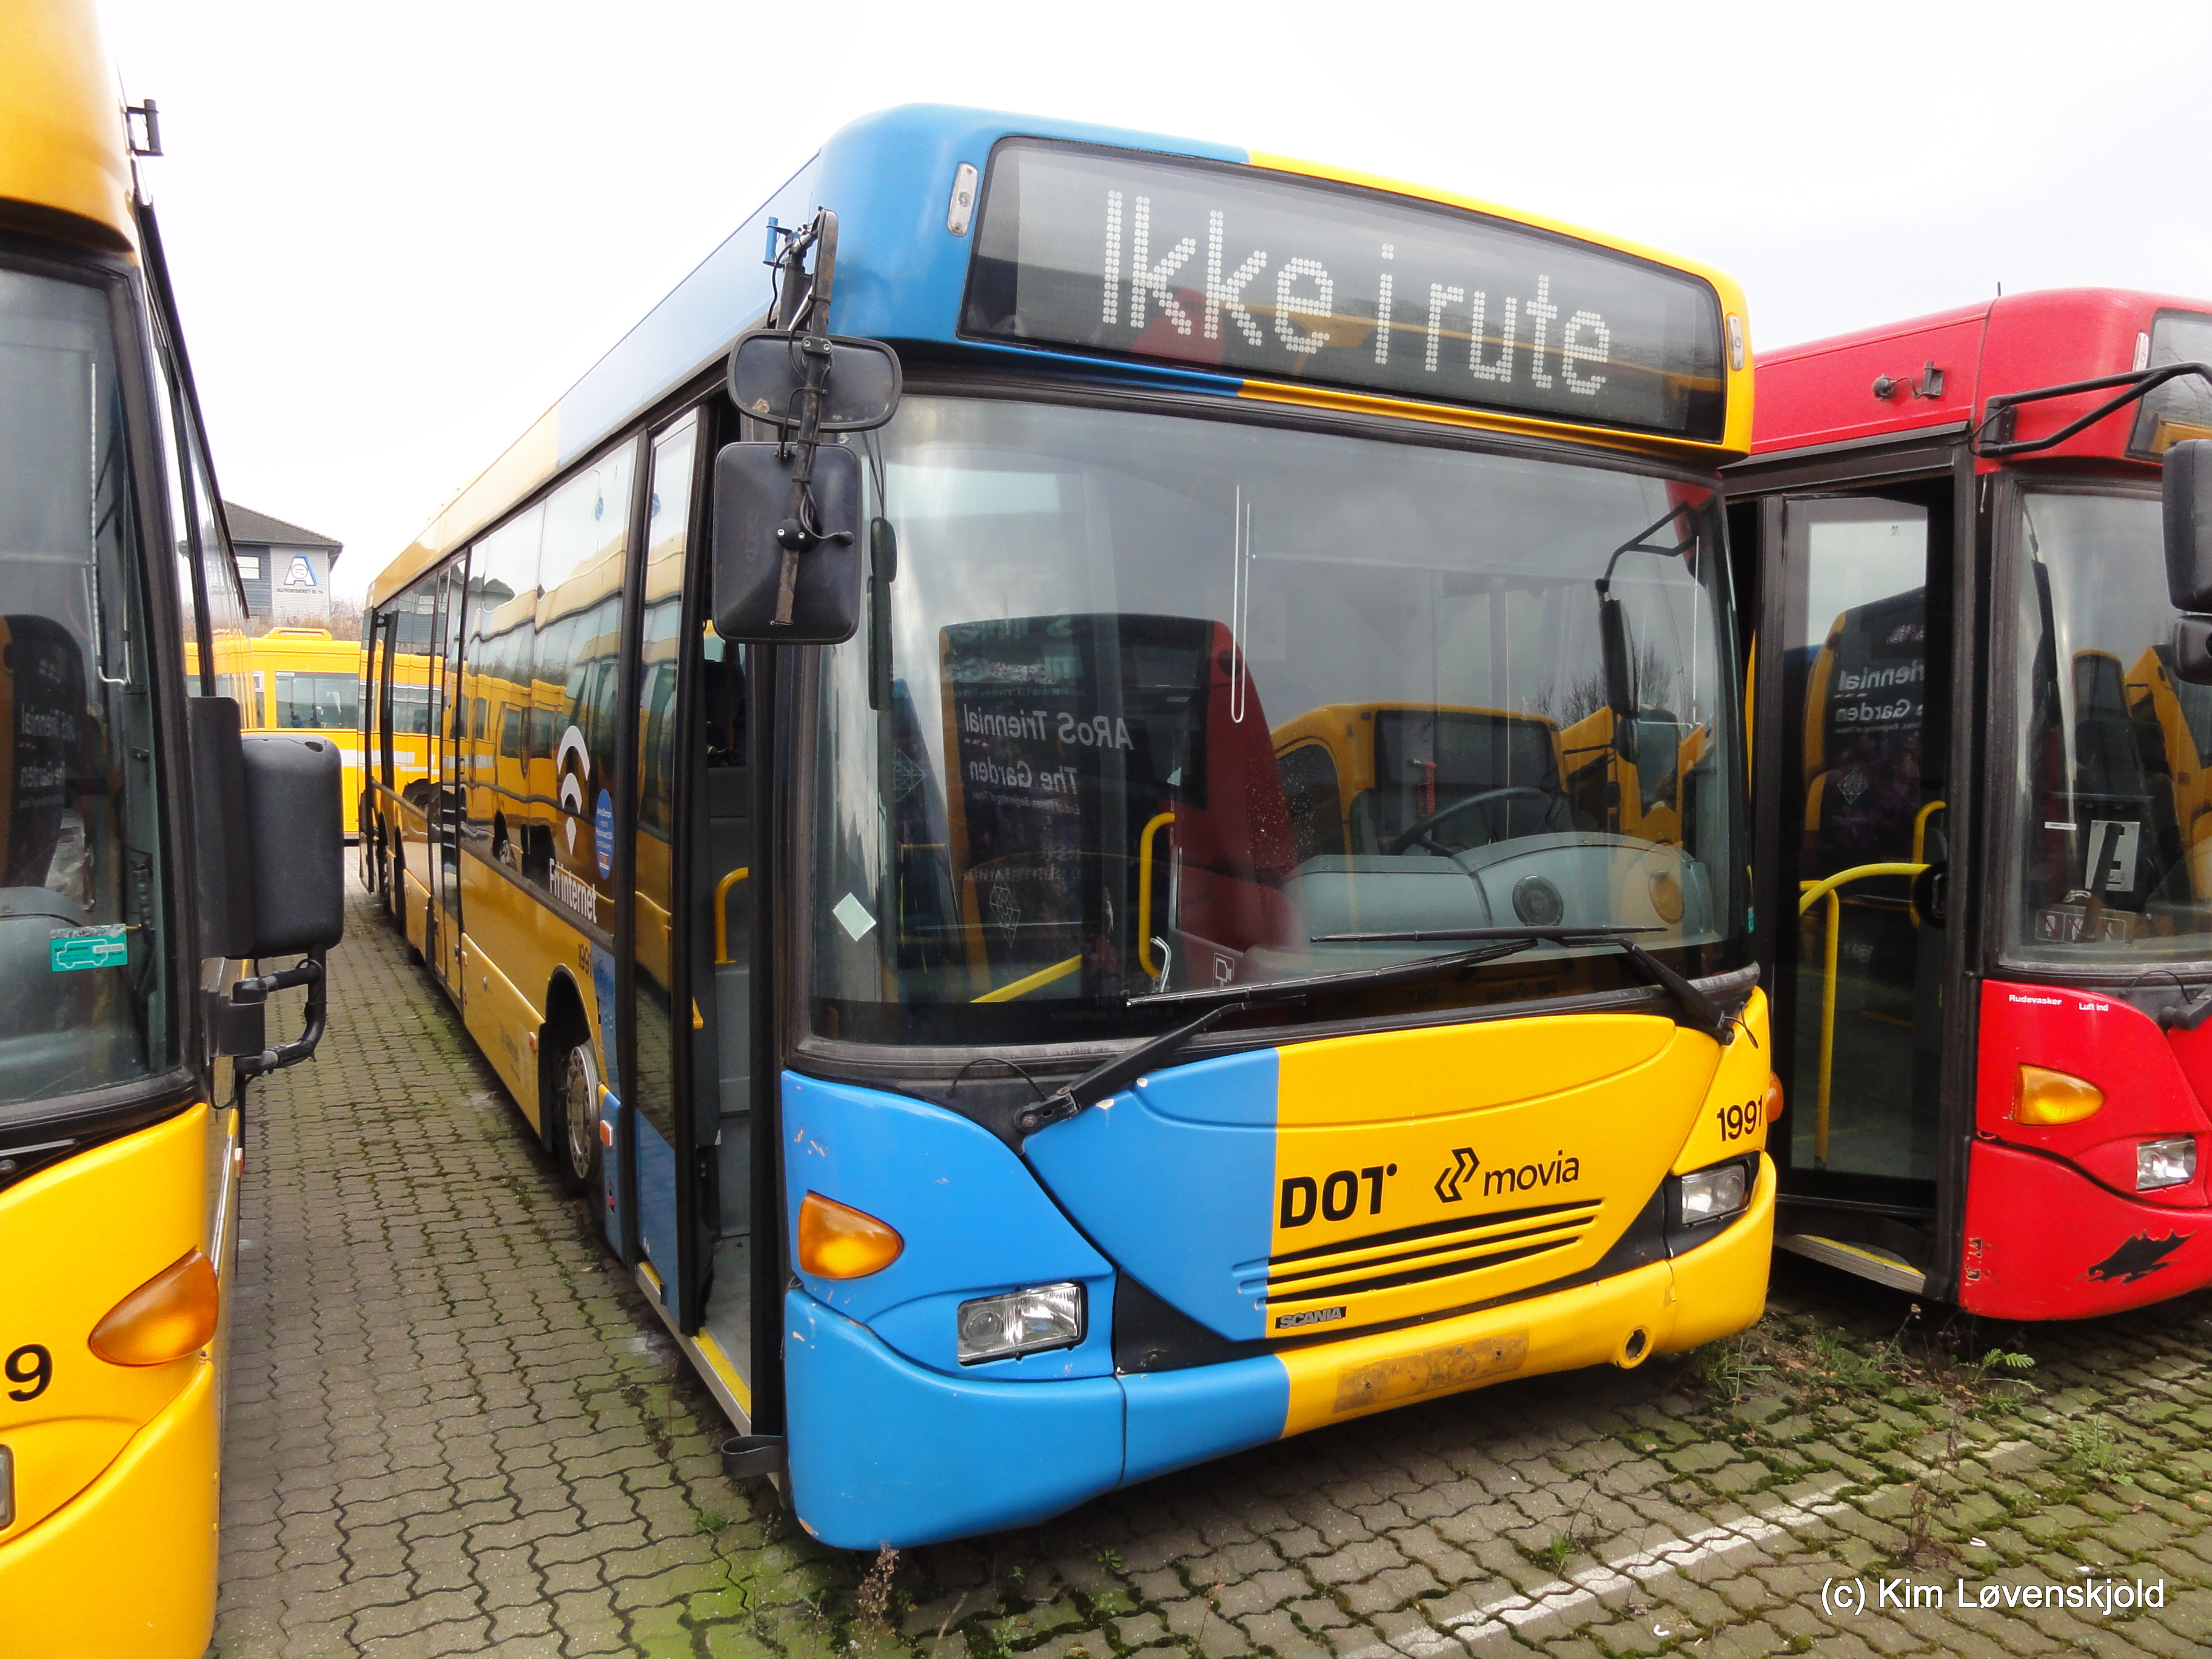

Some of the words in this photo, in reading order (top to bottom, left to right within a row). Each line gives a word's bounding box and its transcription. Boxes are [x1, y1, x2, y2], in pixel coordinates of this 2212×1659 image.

[1103, 190, 1333, 354] Ikke
[1375, 244, 1394, 365] i
[1426, 274, 1610, 396] rute
[549, 857, 560, 899] Fri
[561, 863, 597, 924] internet
[578, 942, 592, 979] 1991
[2008, 994, 2062, 1005] Rudevasker
[2079, 1002, 2094, 1011] Luft
[1716, 1095, 1763, 1142] 1991
[1280, 1163, 1398, 1229] DOT
[1483, 1150, 1580, 1196] movia
[1279, 1306, 1342, 1329] SCANIA
[5, 1343, 53, 1402] 9
